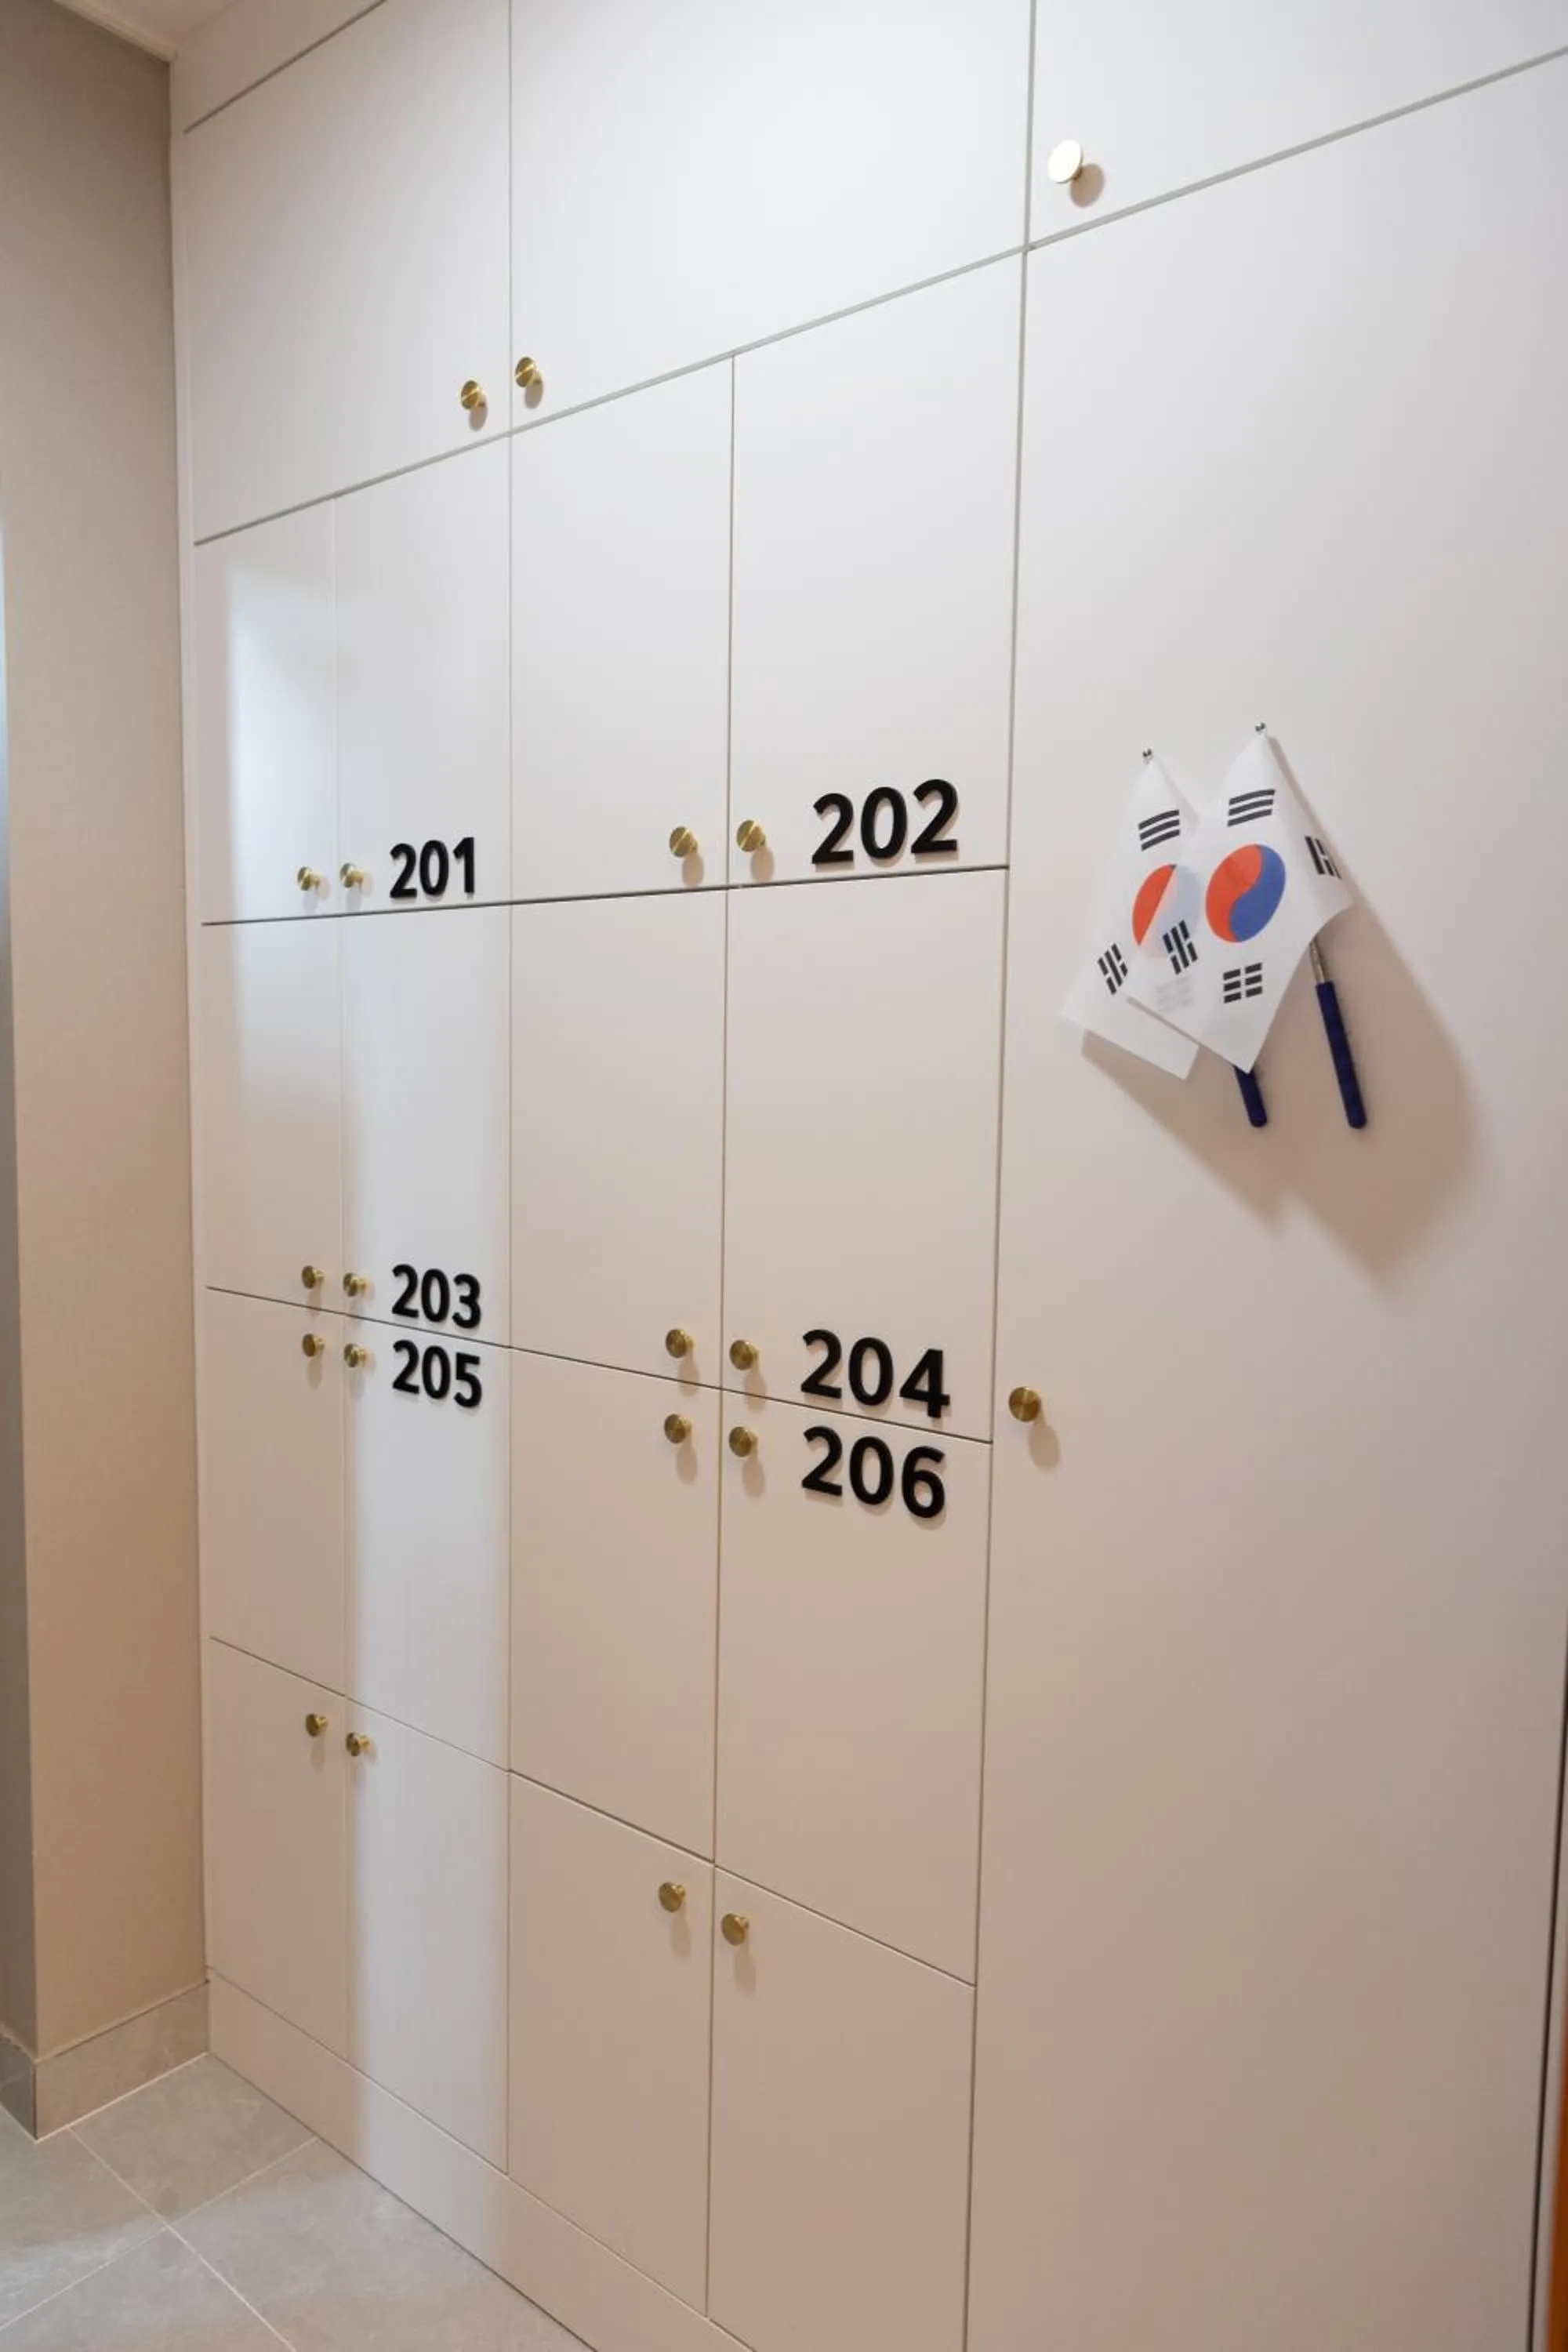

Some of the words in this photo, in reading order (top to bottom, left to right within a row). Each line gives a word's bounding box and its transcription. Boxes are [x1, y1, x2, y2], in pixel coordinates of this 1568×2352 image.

[811, 778, 958, 866] 202
[389, 836, 475, 900] 201
[390, 1263, 482, 1330] 203
[391, 1339, 483, 1410] 205
[800, 1328, 951, 1421] 204
[800, 1425, 946, 1519] 206
